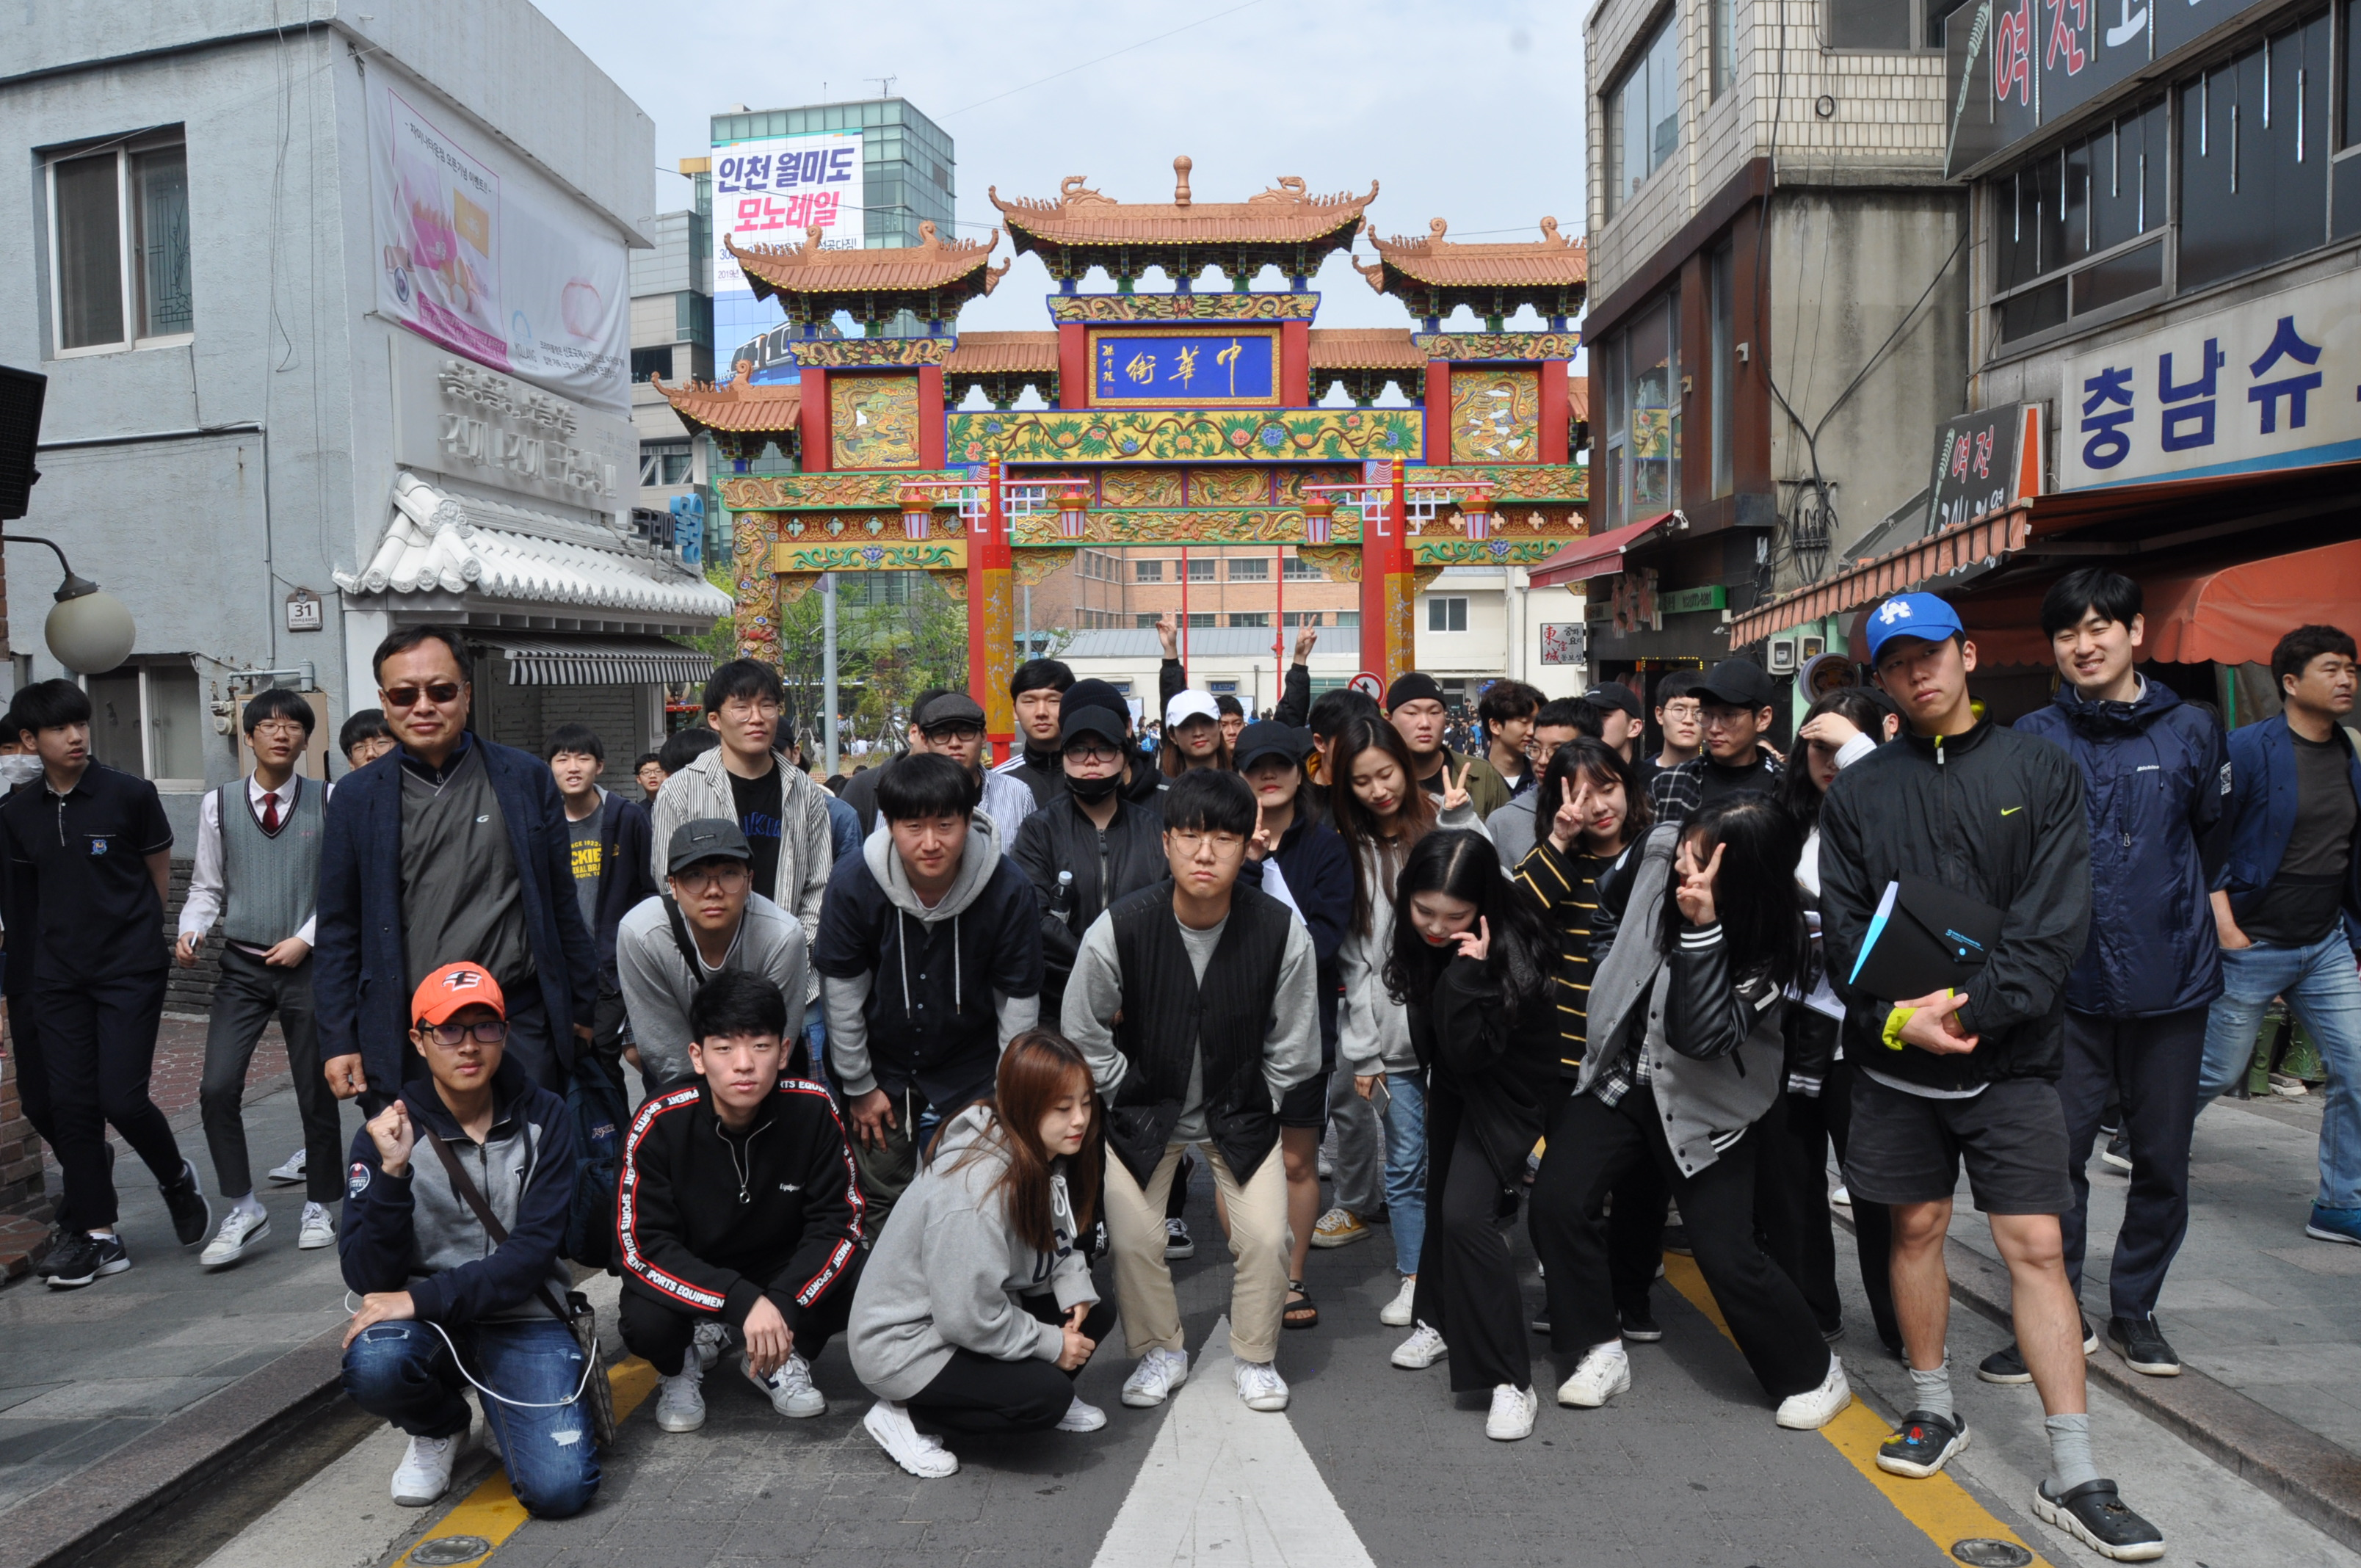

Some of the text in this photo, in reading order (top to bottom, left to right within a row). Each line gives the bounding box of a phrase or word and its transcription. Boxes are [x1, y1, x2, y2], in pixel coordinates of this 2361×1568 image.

[410, 123, 445, 163] 차이나타운점
[446, 153, 468, 181] 오픈기념
[718, 148, 855, 193] 인천 월미도
[734, 191, 840, 233] 모노레일
[2081, 314, 2361, 471] 충남슈
[1952, 424, 1994, 484] 역전
[294, 604, 311, 617] 31
[634, 1102, 661, 1133] SPORTS
[620, 1194, 632, 1230] SPORTS
[622, 1232, 647, 1272] EQUIENT
[675, 1285, 725, 1308] EQUIPMEN
[807, 1268, 833, 1299] SPORTS
